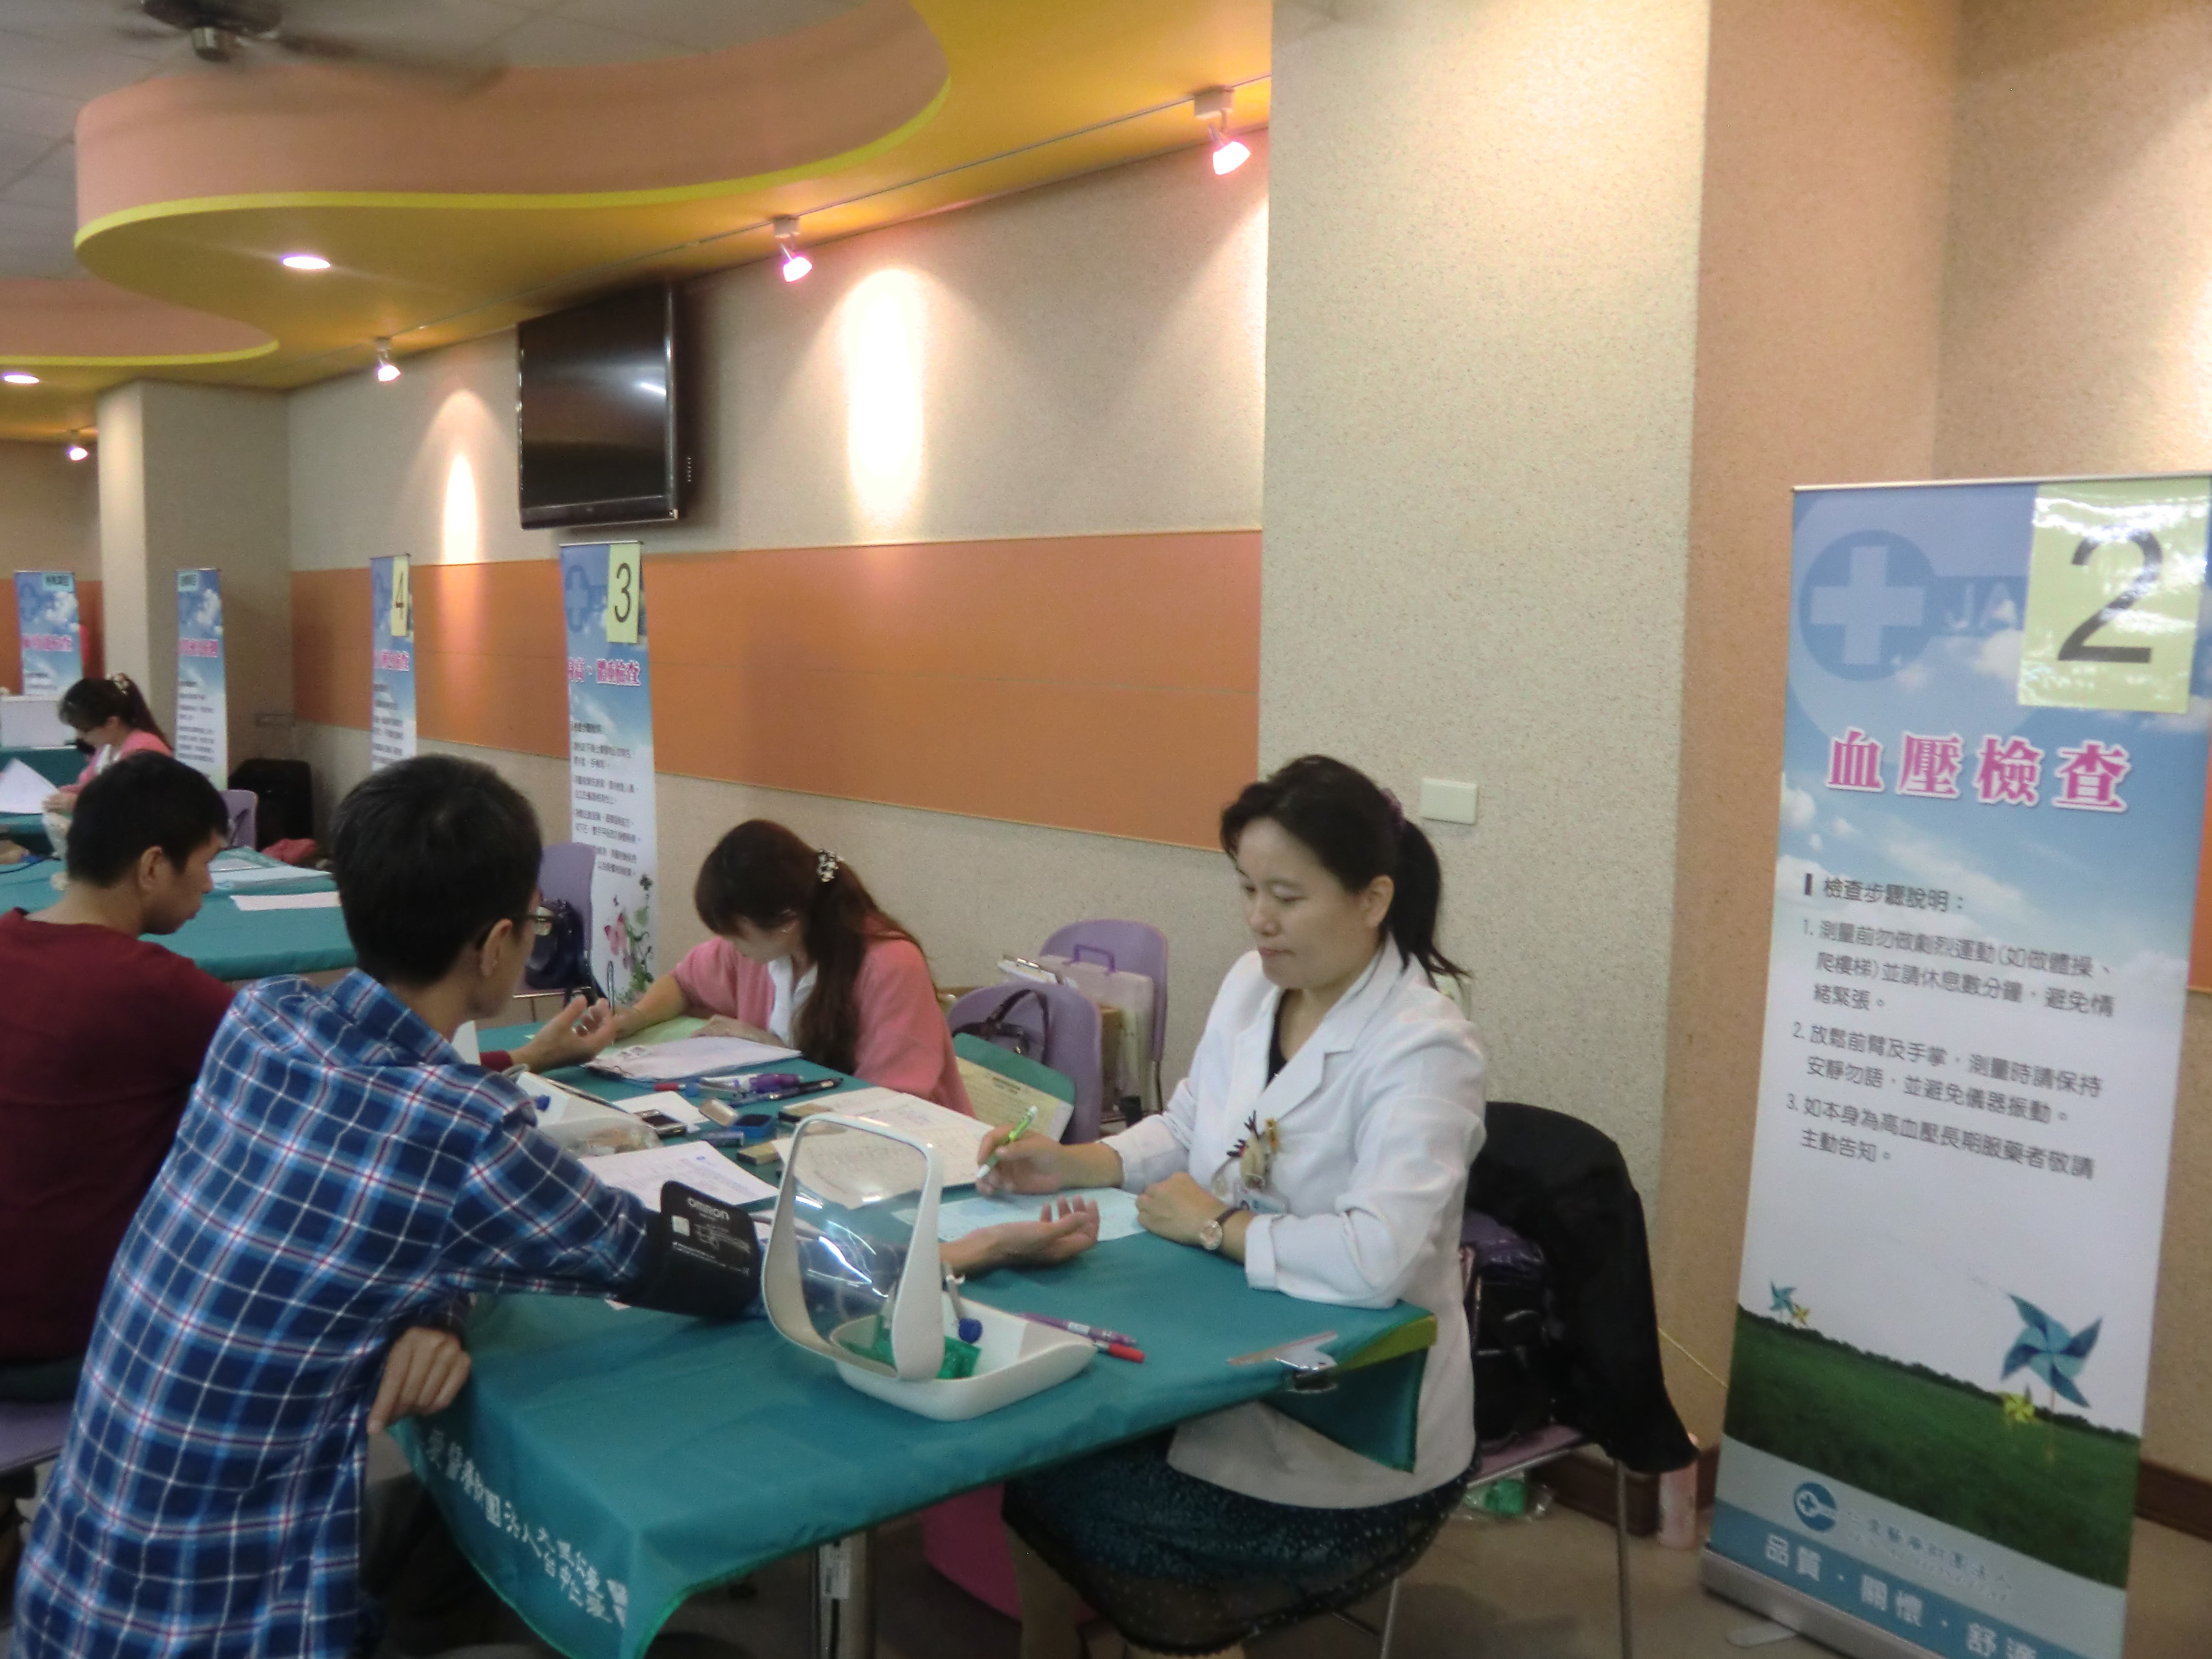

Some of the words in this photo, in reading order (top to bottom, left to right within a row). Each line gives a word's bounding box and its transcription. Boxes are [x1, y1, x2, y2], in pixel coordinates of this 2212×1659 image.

[395, 573, 404, 620] 4
[614, 563, 631, 623] 3
[2058, 525, 2163, 663] 2
[1826, 727, 2131, 813] 血壓檢查
